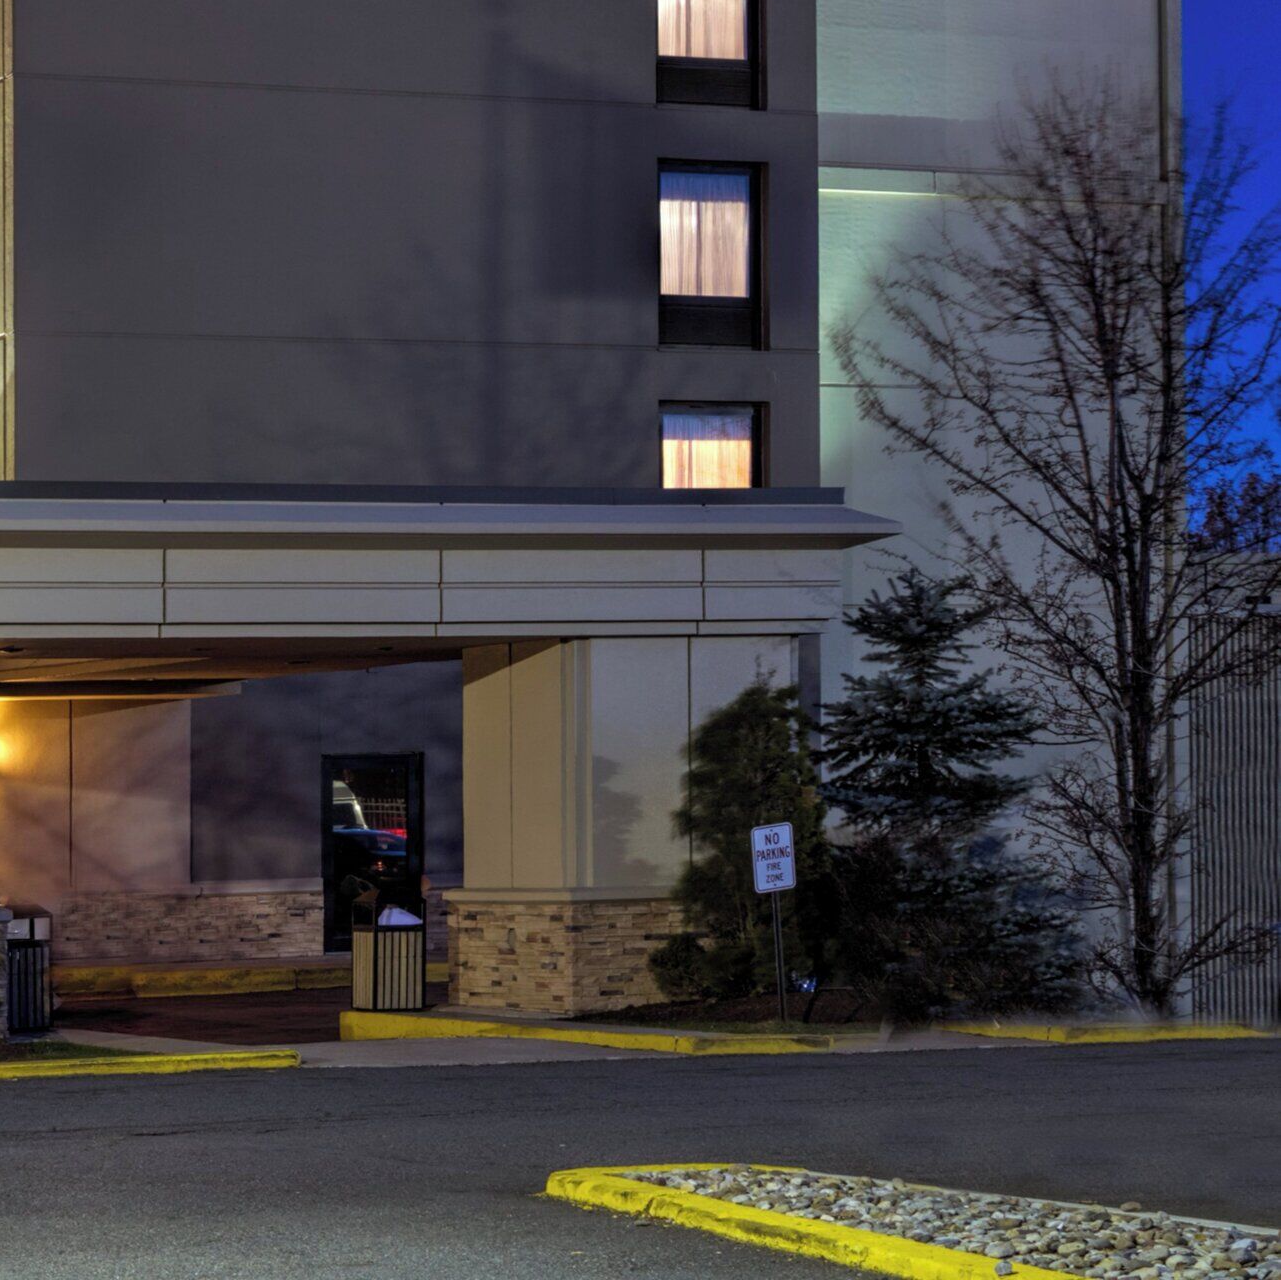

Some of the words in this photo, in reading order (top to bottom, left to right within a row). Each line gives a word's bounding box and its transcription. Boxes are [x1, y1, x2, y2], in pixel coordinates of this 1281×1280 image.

[764, 832, 780, 846] NO
[756, 846, 790, 862] PARKING
[766, 861, 781, 871] FIRE
[766, 872, 784, 883] ZONE
